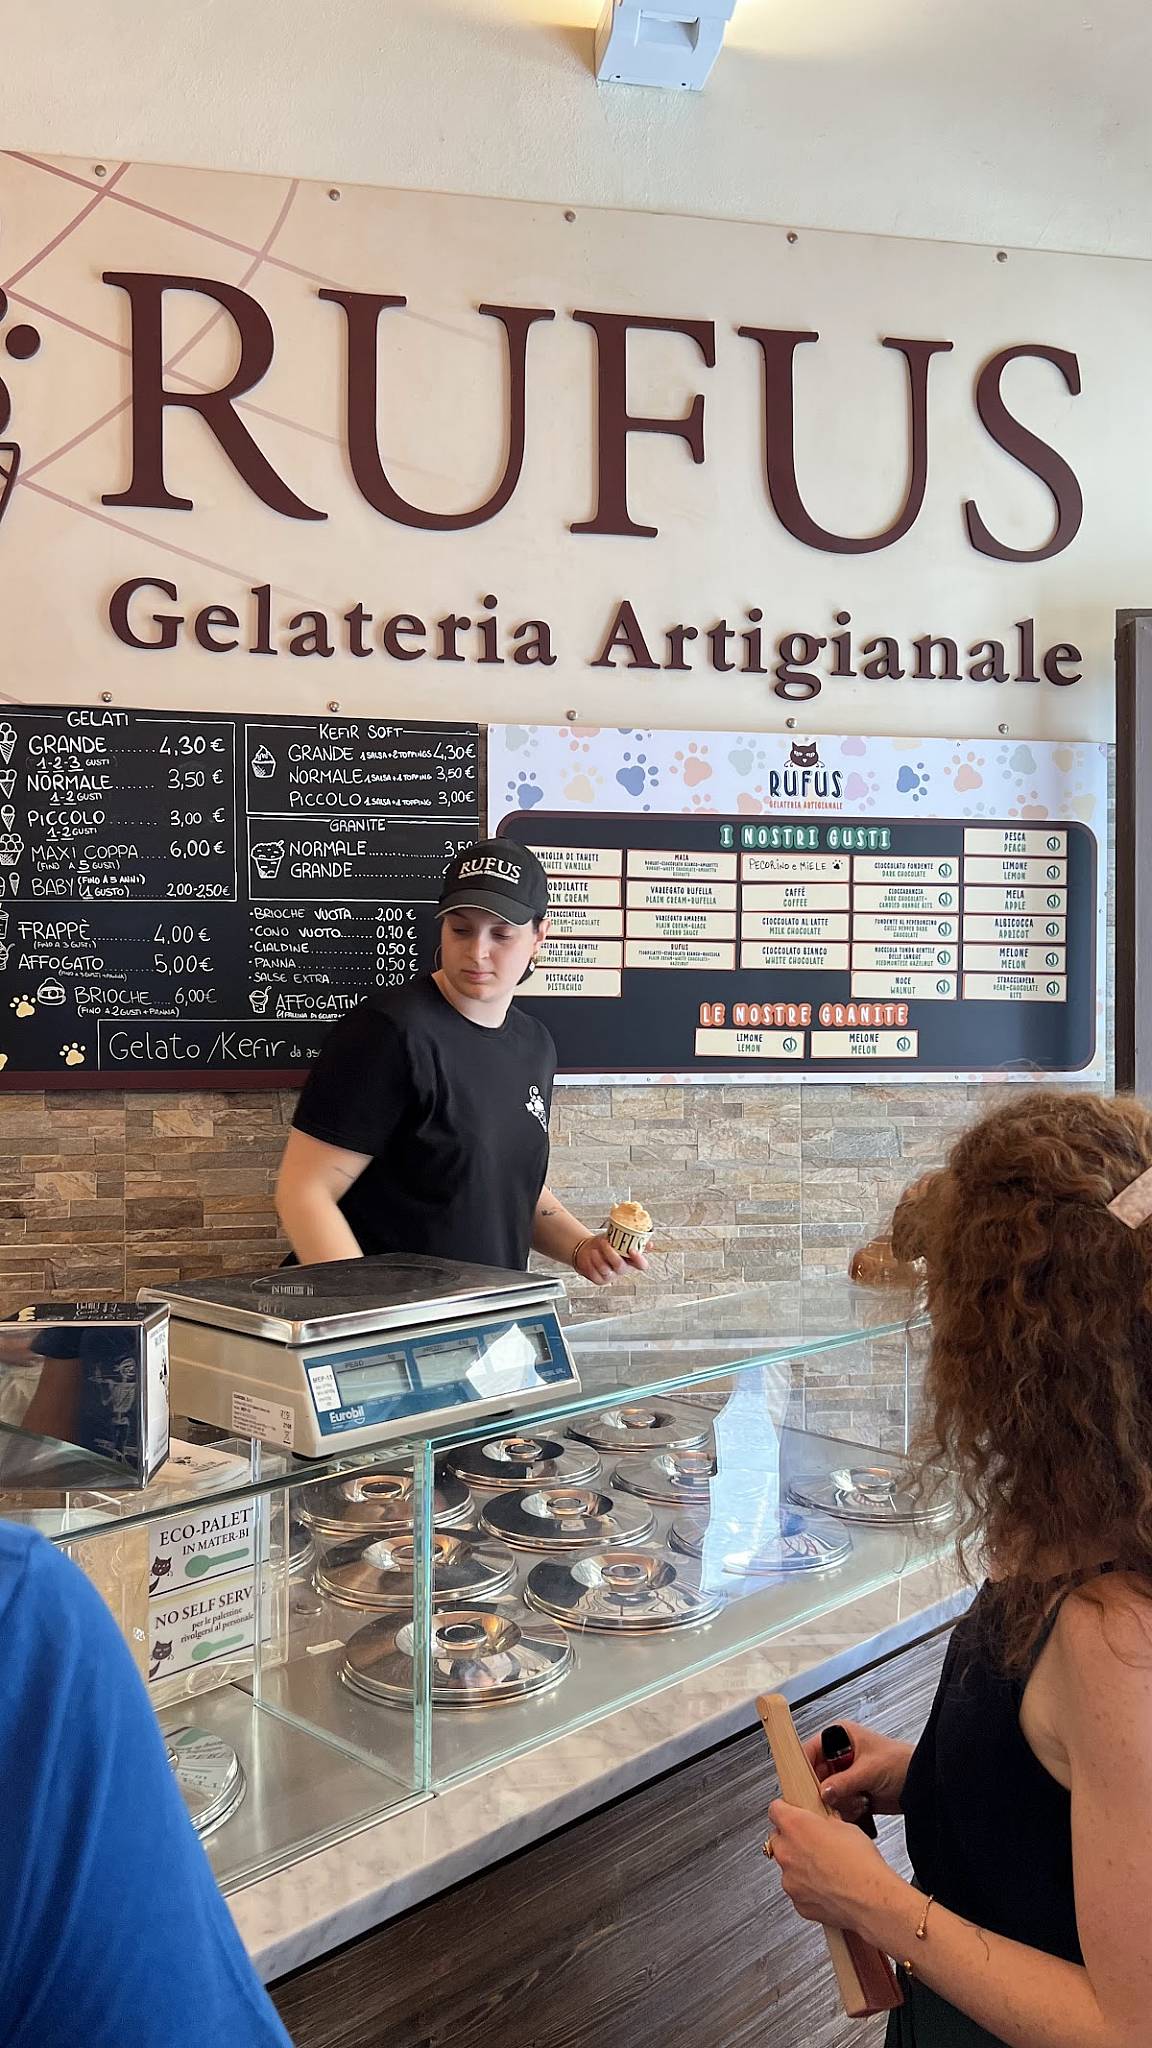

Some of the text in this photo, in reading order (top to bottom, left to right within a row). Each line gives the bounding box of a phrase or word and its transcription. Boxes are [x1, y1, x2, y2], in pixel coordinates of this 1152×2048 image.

[101, 270, 1083, 564] RUFUS
[108, 575, 1084, 702] Gelateria Artigianale
[67, 711, 129, 727] GELATI
[367, 725, 403, 739] SOFT
[29, 735, 107, 755] GRANDE
[288, 744, 354, 761] GRANDE
[86, 758, 110, 767] GUSTI
[27, 774, 113, 791] NORMALE
[168, 768, 205, 790] 3,50
[289, 766, 363, 784] NORMALE
[769, 770, 843, 798] RUFUS
[77, 792, 102, 801] GUSTI
[289, 791, 362, 807] PICCOLO
[28, 810, 106, 827] PICCOLO
[170, 810, 202, 827] 3,00
[330, 818, 386, 832] GRANITE
[72, 828, 97, 836] GUSTI
[723, 828, 888, 847] I NOSTRI GUSTI
[1004, 832, 1026, 841] PESCA
[31, 845, 76, 862] MAXI
[83, 844, 139, 860] COPPA
[289, 841, 367, 857] NORMALE
[1004, 843, 1026, 852] PEACH
[291, 862, 353, 878] GRANDE
[460, 857, 521, 879] RUFUS
[565, 862, 592, 870] VANILLA
[1002, 861, 1027, 870] LIMONE
[1004, 871, 1026, 880] LEMON
[31, 878, 74, 896] BABY
[564, 894, 589, 902] CREAM
[1006, 890, 1025, 899] MELA
[783, 898, 808, 907] COFFEE
[1004, 901, 1026, 910] APPLE
[254, 907, 305, 919] BRIOCHE
[314, 908, 352, 921] VUOTA
[762, 917, 829, 926] CIOCCOLATO AL LATTE
[995, 918, 1034, 928] ALBICOCCA
[153, 923, 194, 944] 4,00
[254, 926, 289, 937] CONO
[299, 928, 342, 938] VUOTO
[769, 927, 821, 935] MILK CHOCOLATE
[999, 930, 1030, 938] APRICOT
[254, 942, 310, 954] CIALDINE
[762, 947, 828, 955] CIOCCOLATO BIANCO
[1000, 948, 1029, 958] MELONE
[18, 953, 104, 970] AFFOGATO
[254, 957, 296, 969] PANNA
[765, 956, 824, 965] WHITE CHOCOLATE
[1001, 960, 1026, 969] MELON
[253, 974, 288, 984] SALSE
[293, 974, 330, 984] EXTRA
[546, 974, 584, 982] PISTACCHIO
[548, 983, 582, 991] PISTACHIO
[74, 986, 151, 1004] BRIOCHE
[702, 1006, 906, 1024] LE NOSTRE GRANITE
[736, 1033, 763, 1042] LIMONE
[849, 1033, 879, 1042] MELONE
[109, 1031, 201, 1060] Gelato
[290, 1044, 302, 1058] da
[737, 1044, 761, 1052] LEMON
[851, 1045, 877, 1054] MELON
[329, 1405, 365, 1423] Eurobil
[182, 1544, 196, 1556] IN
[155, 1597, 216, 1629] NO SELF
[180, 1613, 255, 1643] rivolgersi al personale
[191, 1618, 204, 1631] per
[204, 1615, 211, 1625] le
